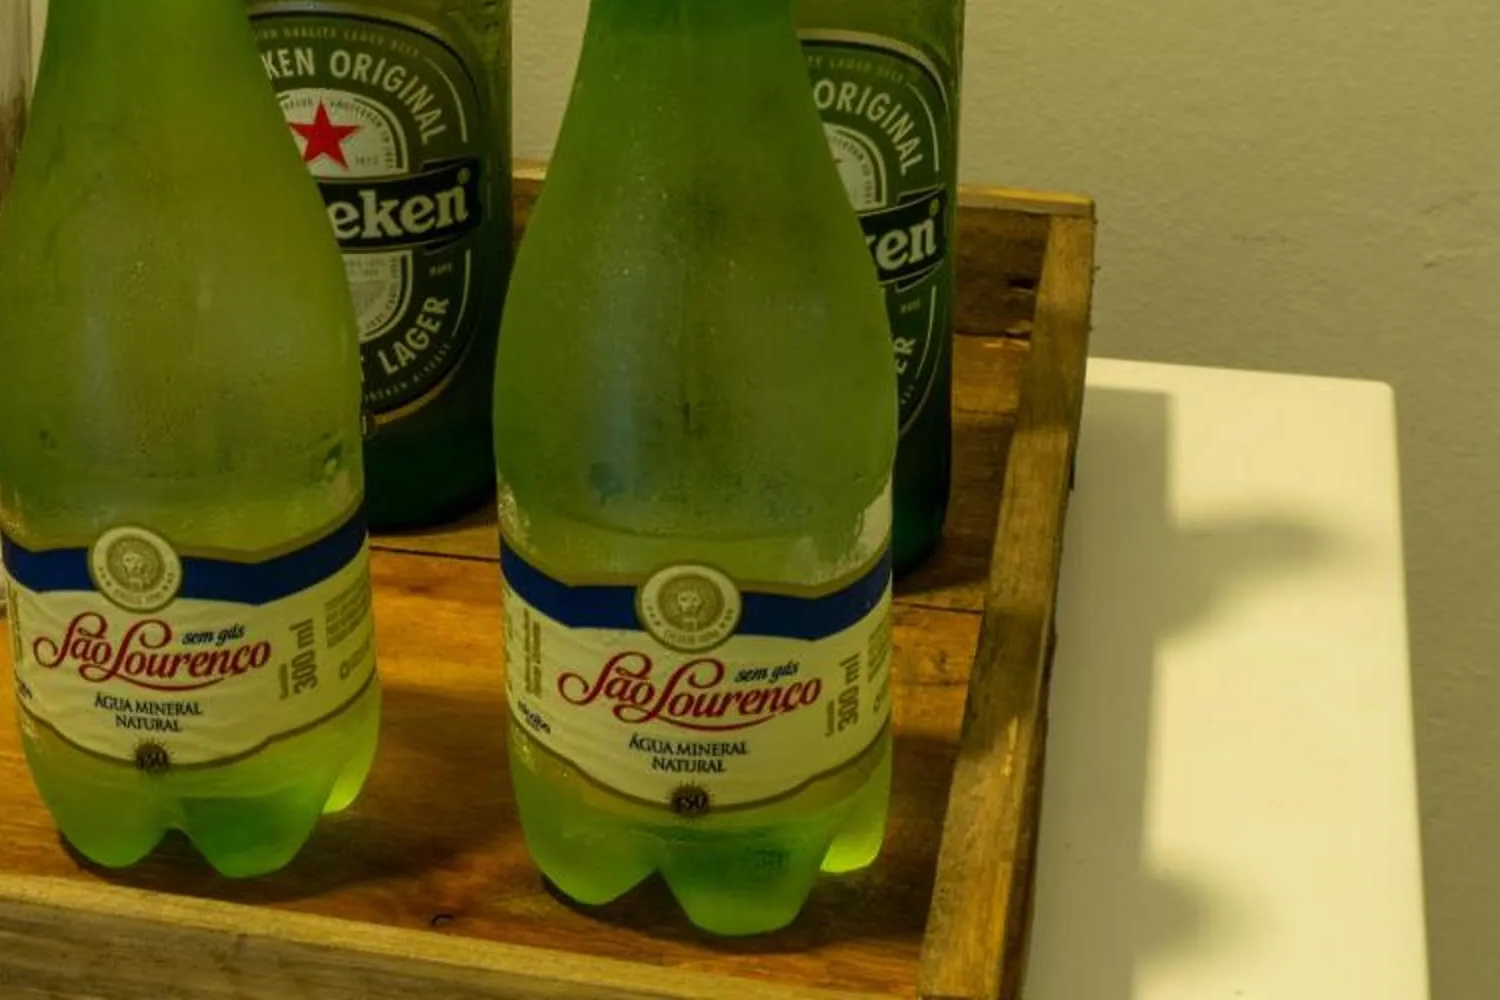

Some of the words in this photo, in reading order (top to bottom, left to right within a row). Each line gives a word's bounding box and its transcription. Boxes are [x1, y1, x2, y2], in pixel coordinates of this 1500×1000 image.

[258, 47, 316, 80] KEN
[329, 48, 448, 147] ORIGINAL
[813, 78, 924, 178] ORIGINAL
[327, 184, 470, 240] eken
[377, 296, 451, 376] LAGER
[33, 611, 113, 669] São
[181, 629, 215, 646] sem
[288, 617, 315, 649] ml
[291, 649, 319, 696] 300
[557, 650, 656, 706] São
[734, 668, 769, 684] sem
[115, 714, 184, 733] NATURAL
[135, 700, 205, 718] MINERAL
[836, 684, 860, 733] 300
[651, 756, 727, 774] NATURAL
[676, 740, 749, 757] MINERAL
